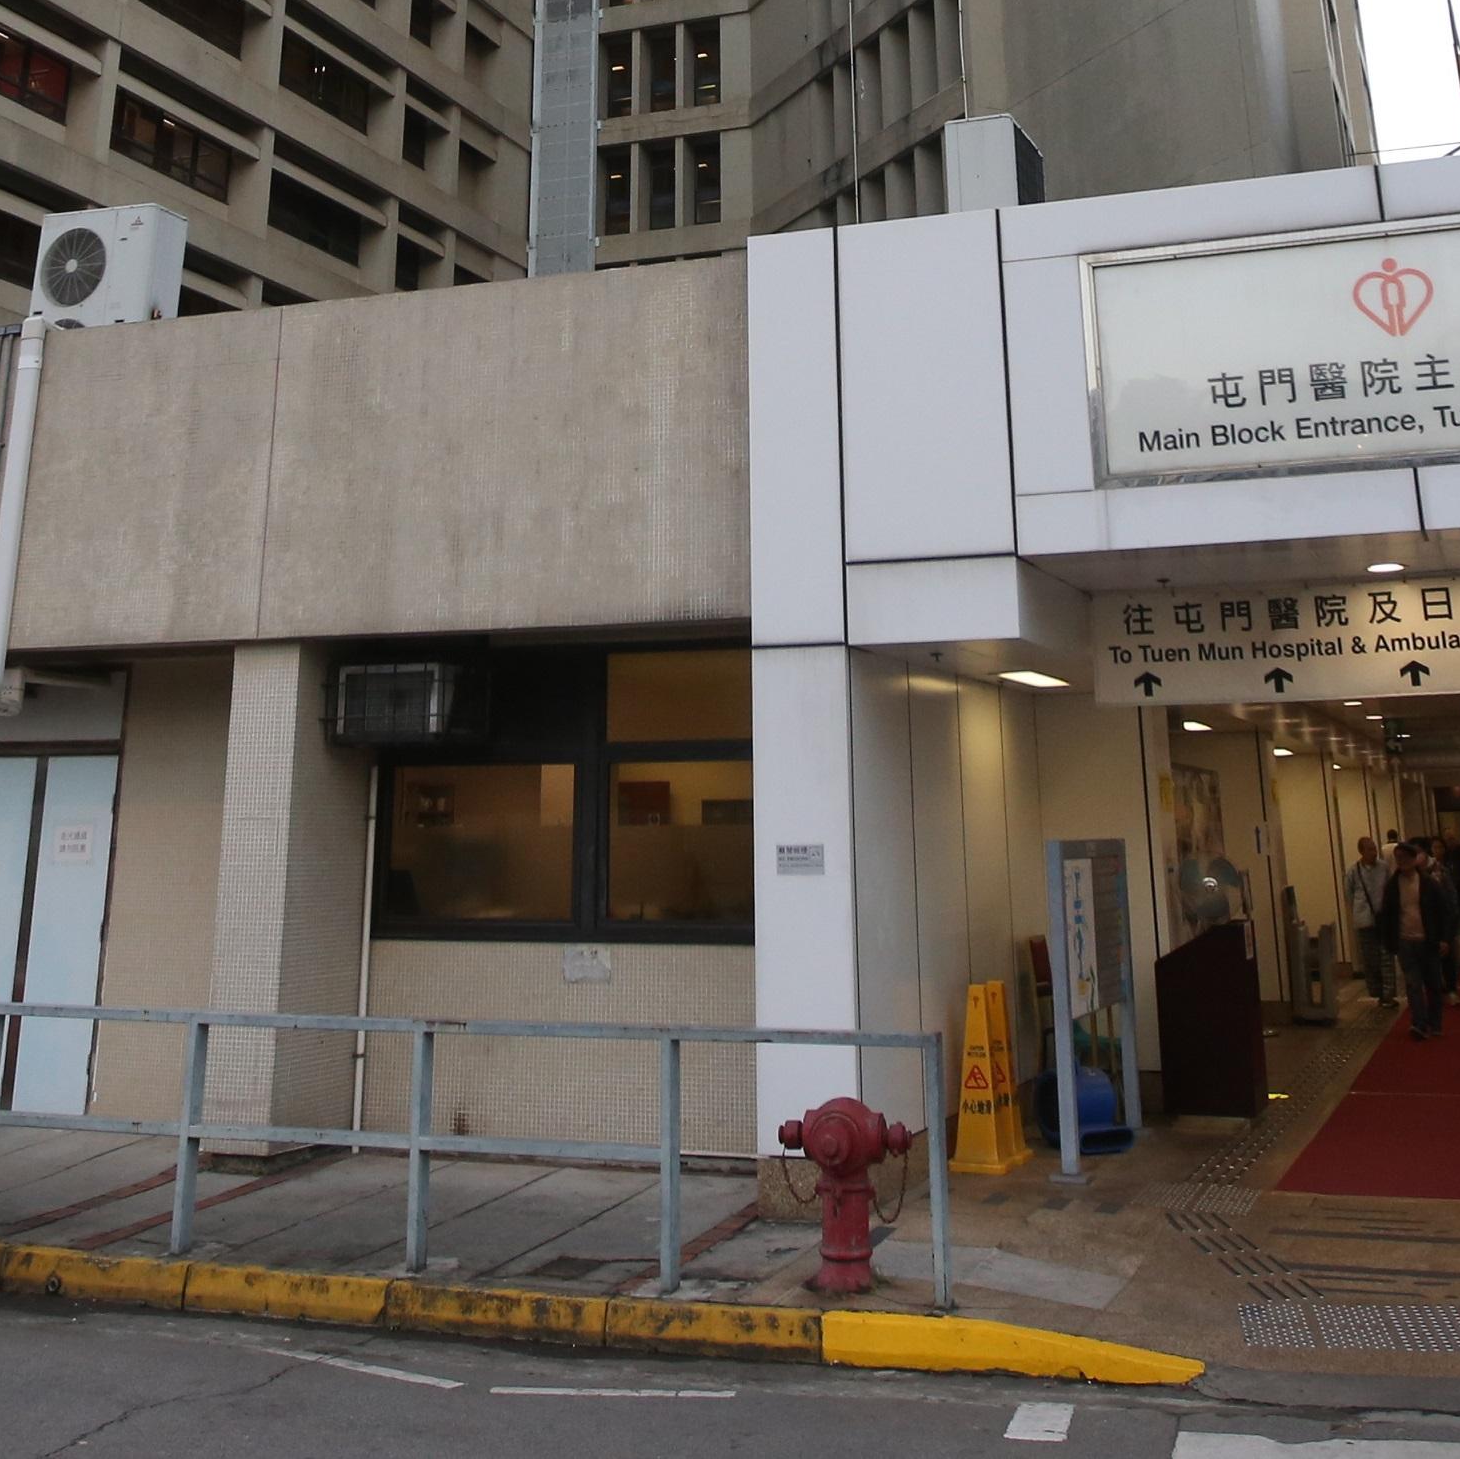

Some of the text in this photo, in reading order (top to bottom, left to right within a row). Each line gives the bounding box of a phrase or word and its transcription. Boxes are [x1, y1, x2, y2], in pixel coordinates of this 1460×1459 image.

[1139, 428, 1201, 452] Main
[1211, 420, 1286, 447] Block
[1295, 412, 1425, 440] Entrance,
[1108, 646, 1133, 665] To
[1138, 644, 1191, 663] Tuen
[1198, 642, 1244, 661] Mun
[1251, 636, 1343, 663] Hospital
[1350, 635, 1366, 654] &
